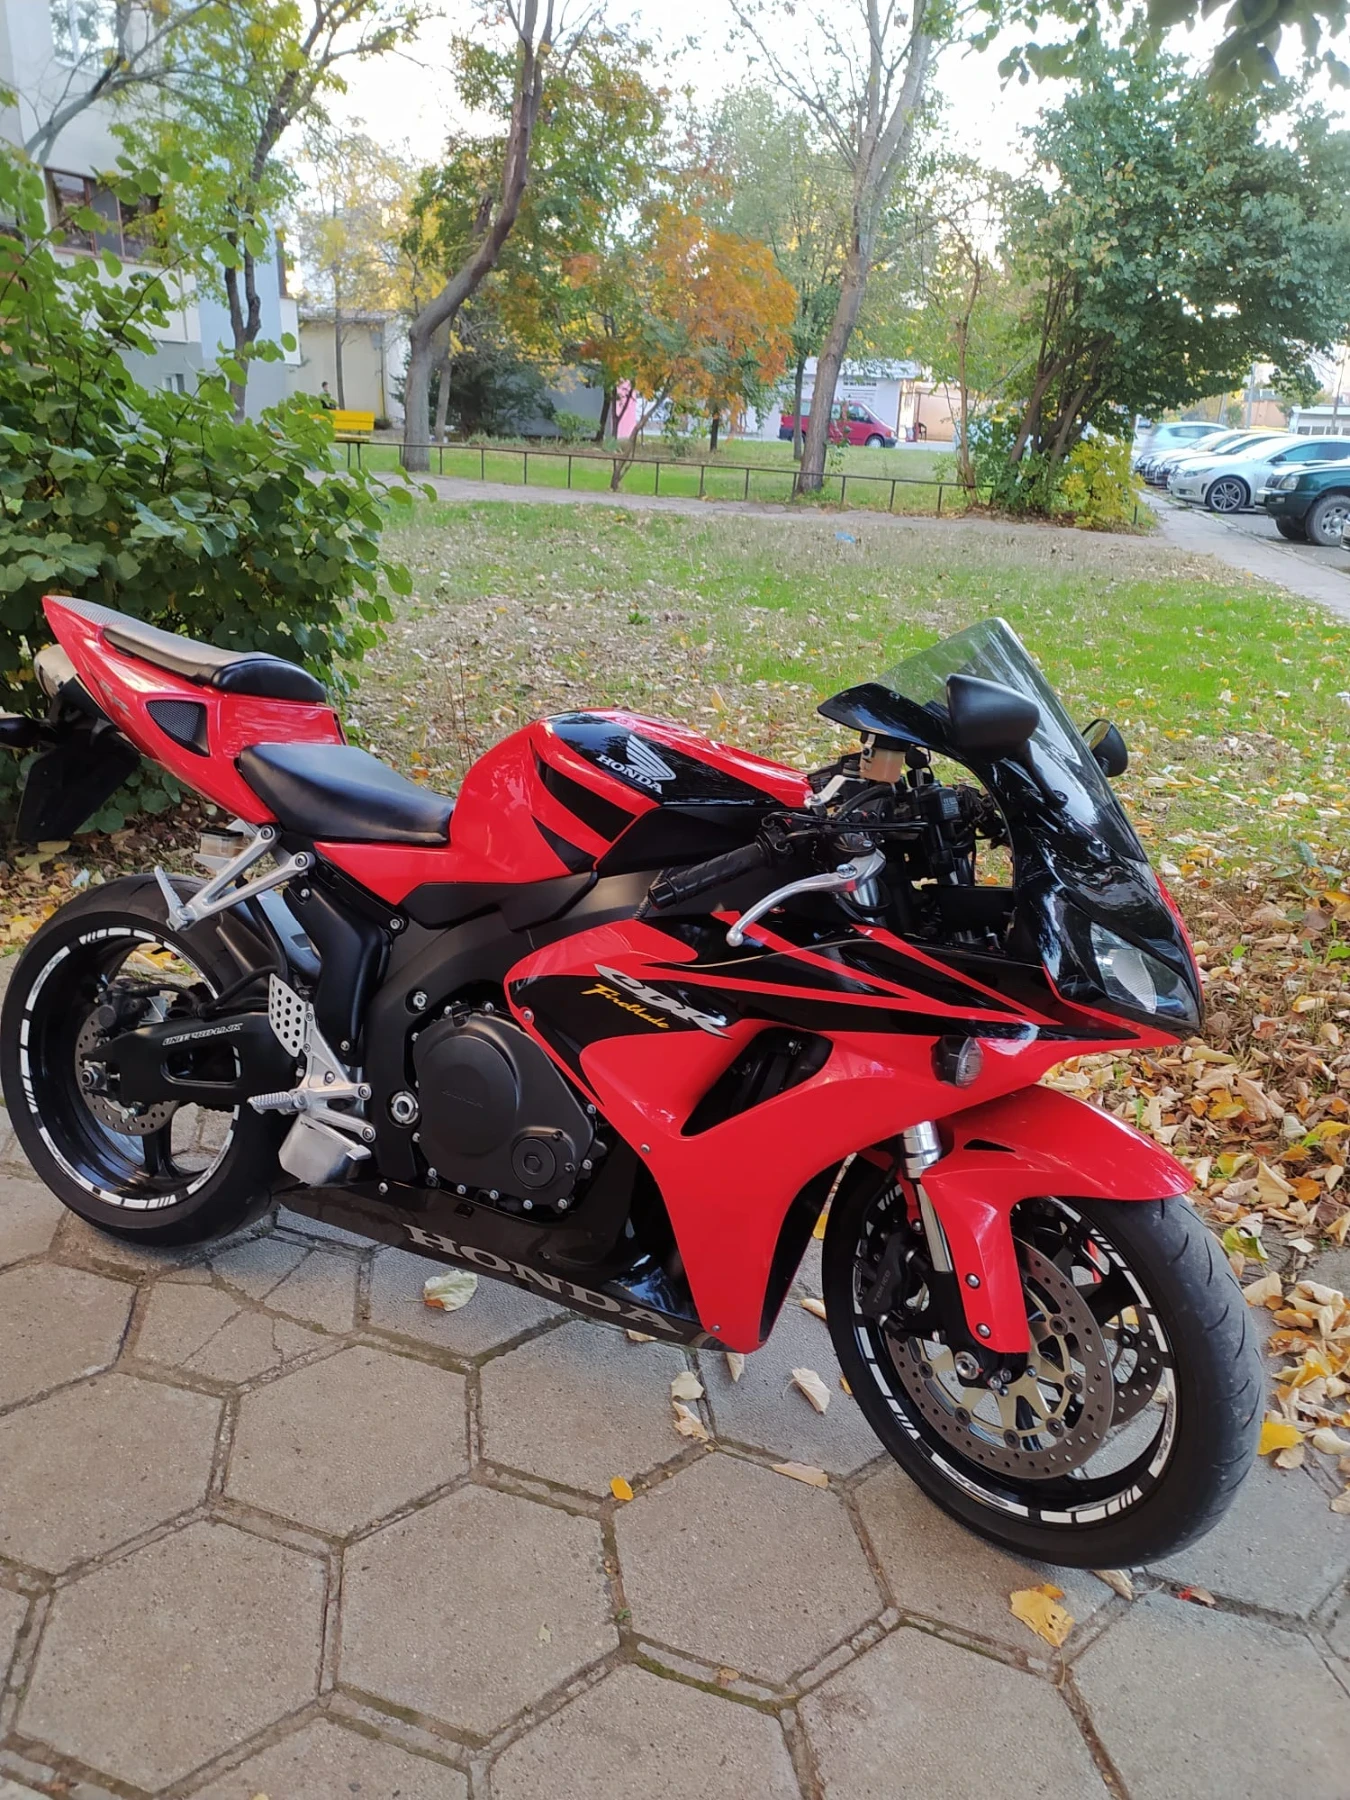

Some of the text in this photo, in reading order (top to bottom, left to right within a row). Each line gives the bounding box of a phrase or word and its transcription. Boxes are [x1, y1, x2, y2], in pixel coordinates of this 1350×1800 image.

[596, 754, 663, 795] HONDA
[581, 983, 670, 1029] Fireblade
[594, 963, 733, 1040] CBR
[402, 1223, 684, 1335] HONDA
